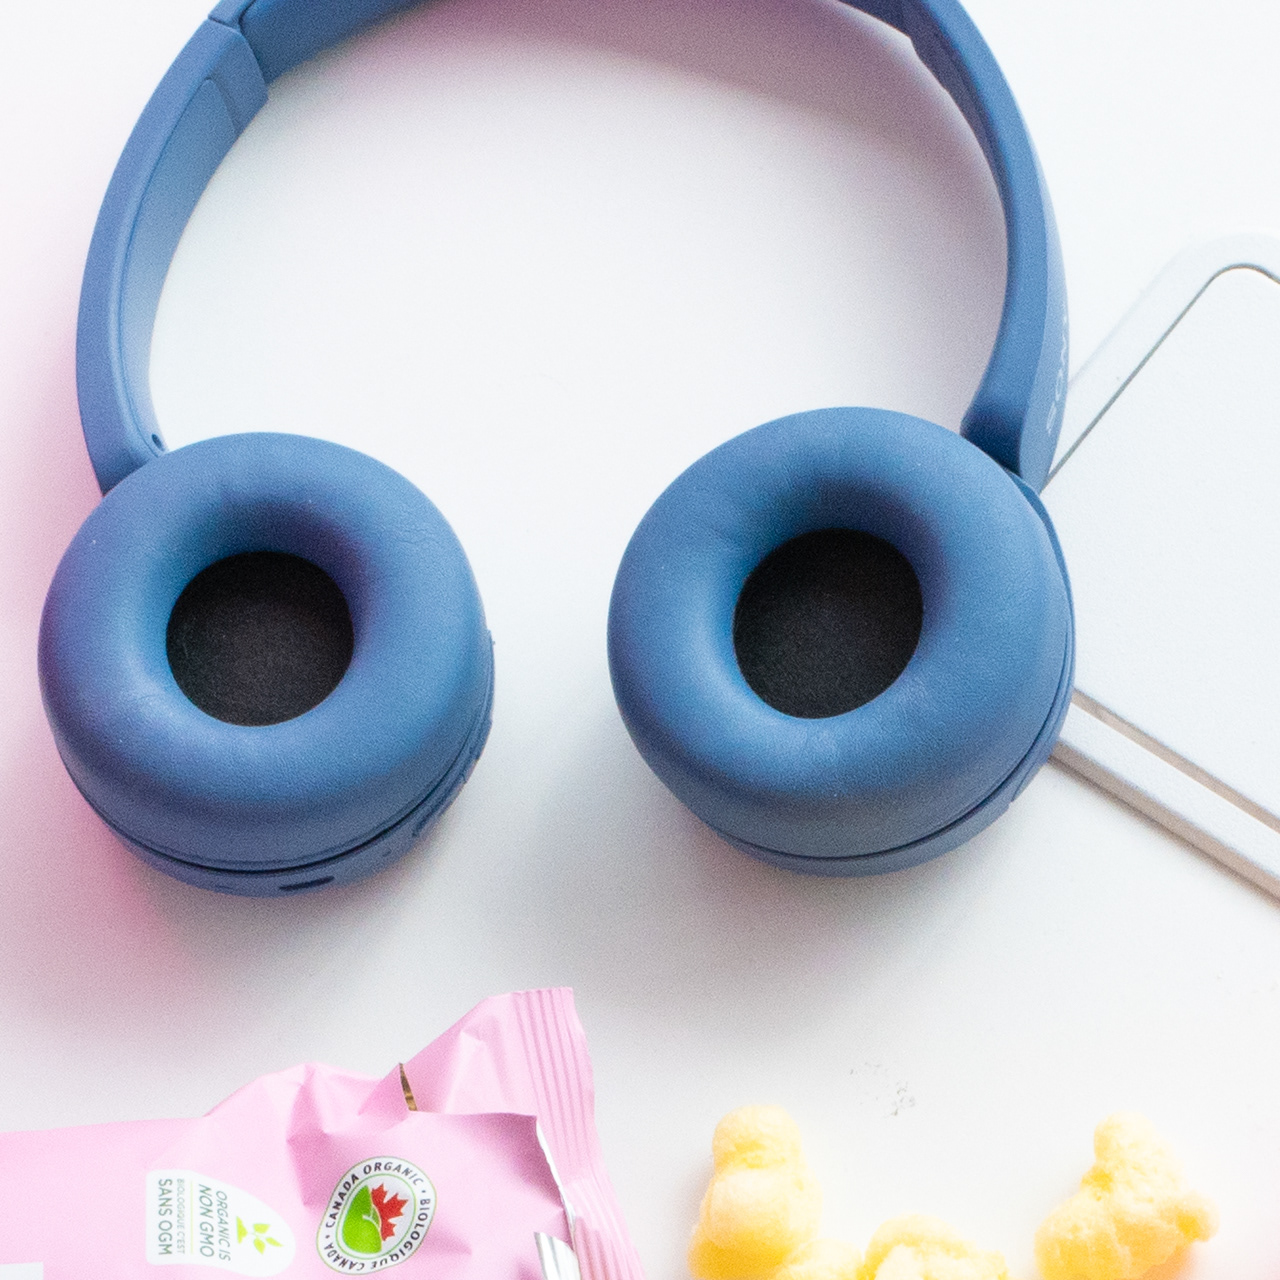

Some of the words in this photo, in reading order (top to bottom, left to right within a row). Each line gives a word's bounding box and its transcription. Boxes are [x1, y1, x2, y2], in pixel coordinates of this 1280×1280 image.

[158, 1178, 173, 1217] SANS
[176, 1178, 185, 1230] BIOLOGIQUE
[198, 1184, 214, 1219] NON
[326, 1173, 359, 1229] CANADA
[363, 1162, 423, 1186] ORGANIC
[158, 1220, 173, 1256] OGM
[215, 1190, 231, 1248] ORGANIC
[370, 1198, 431, 1269] BIOLOGIQUE
[199, 1221, 215, 1258] GMO
[218, 1249, 231, 1262] IS
[324, 1242, 365, 1272] CANADA
